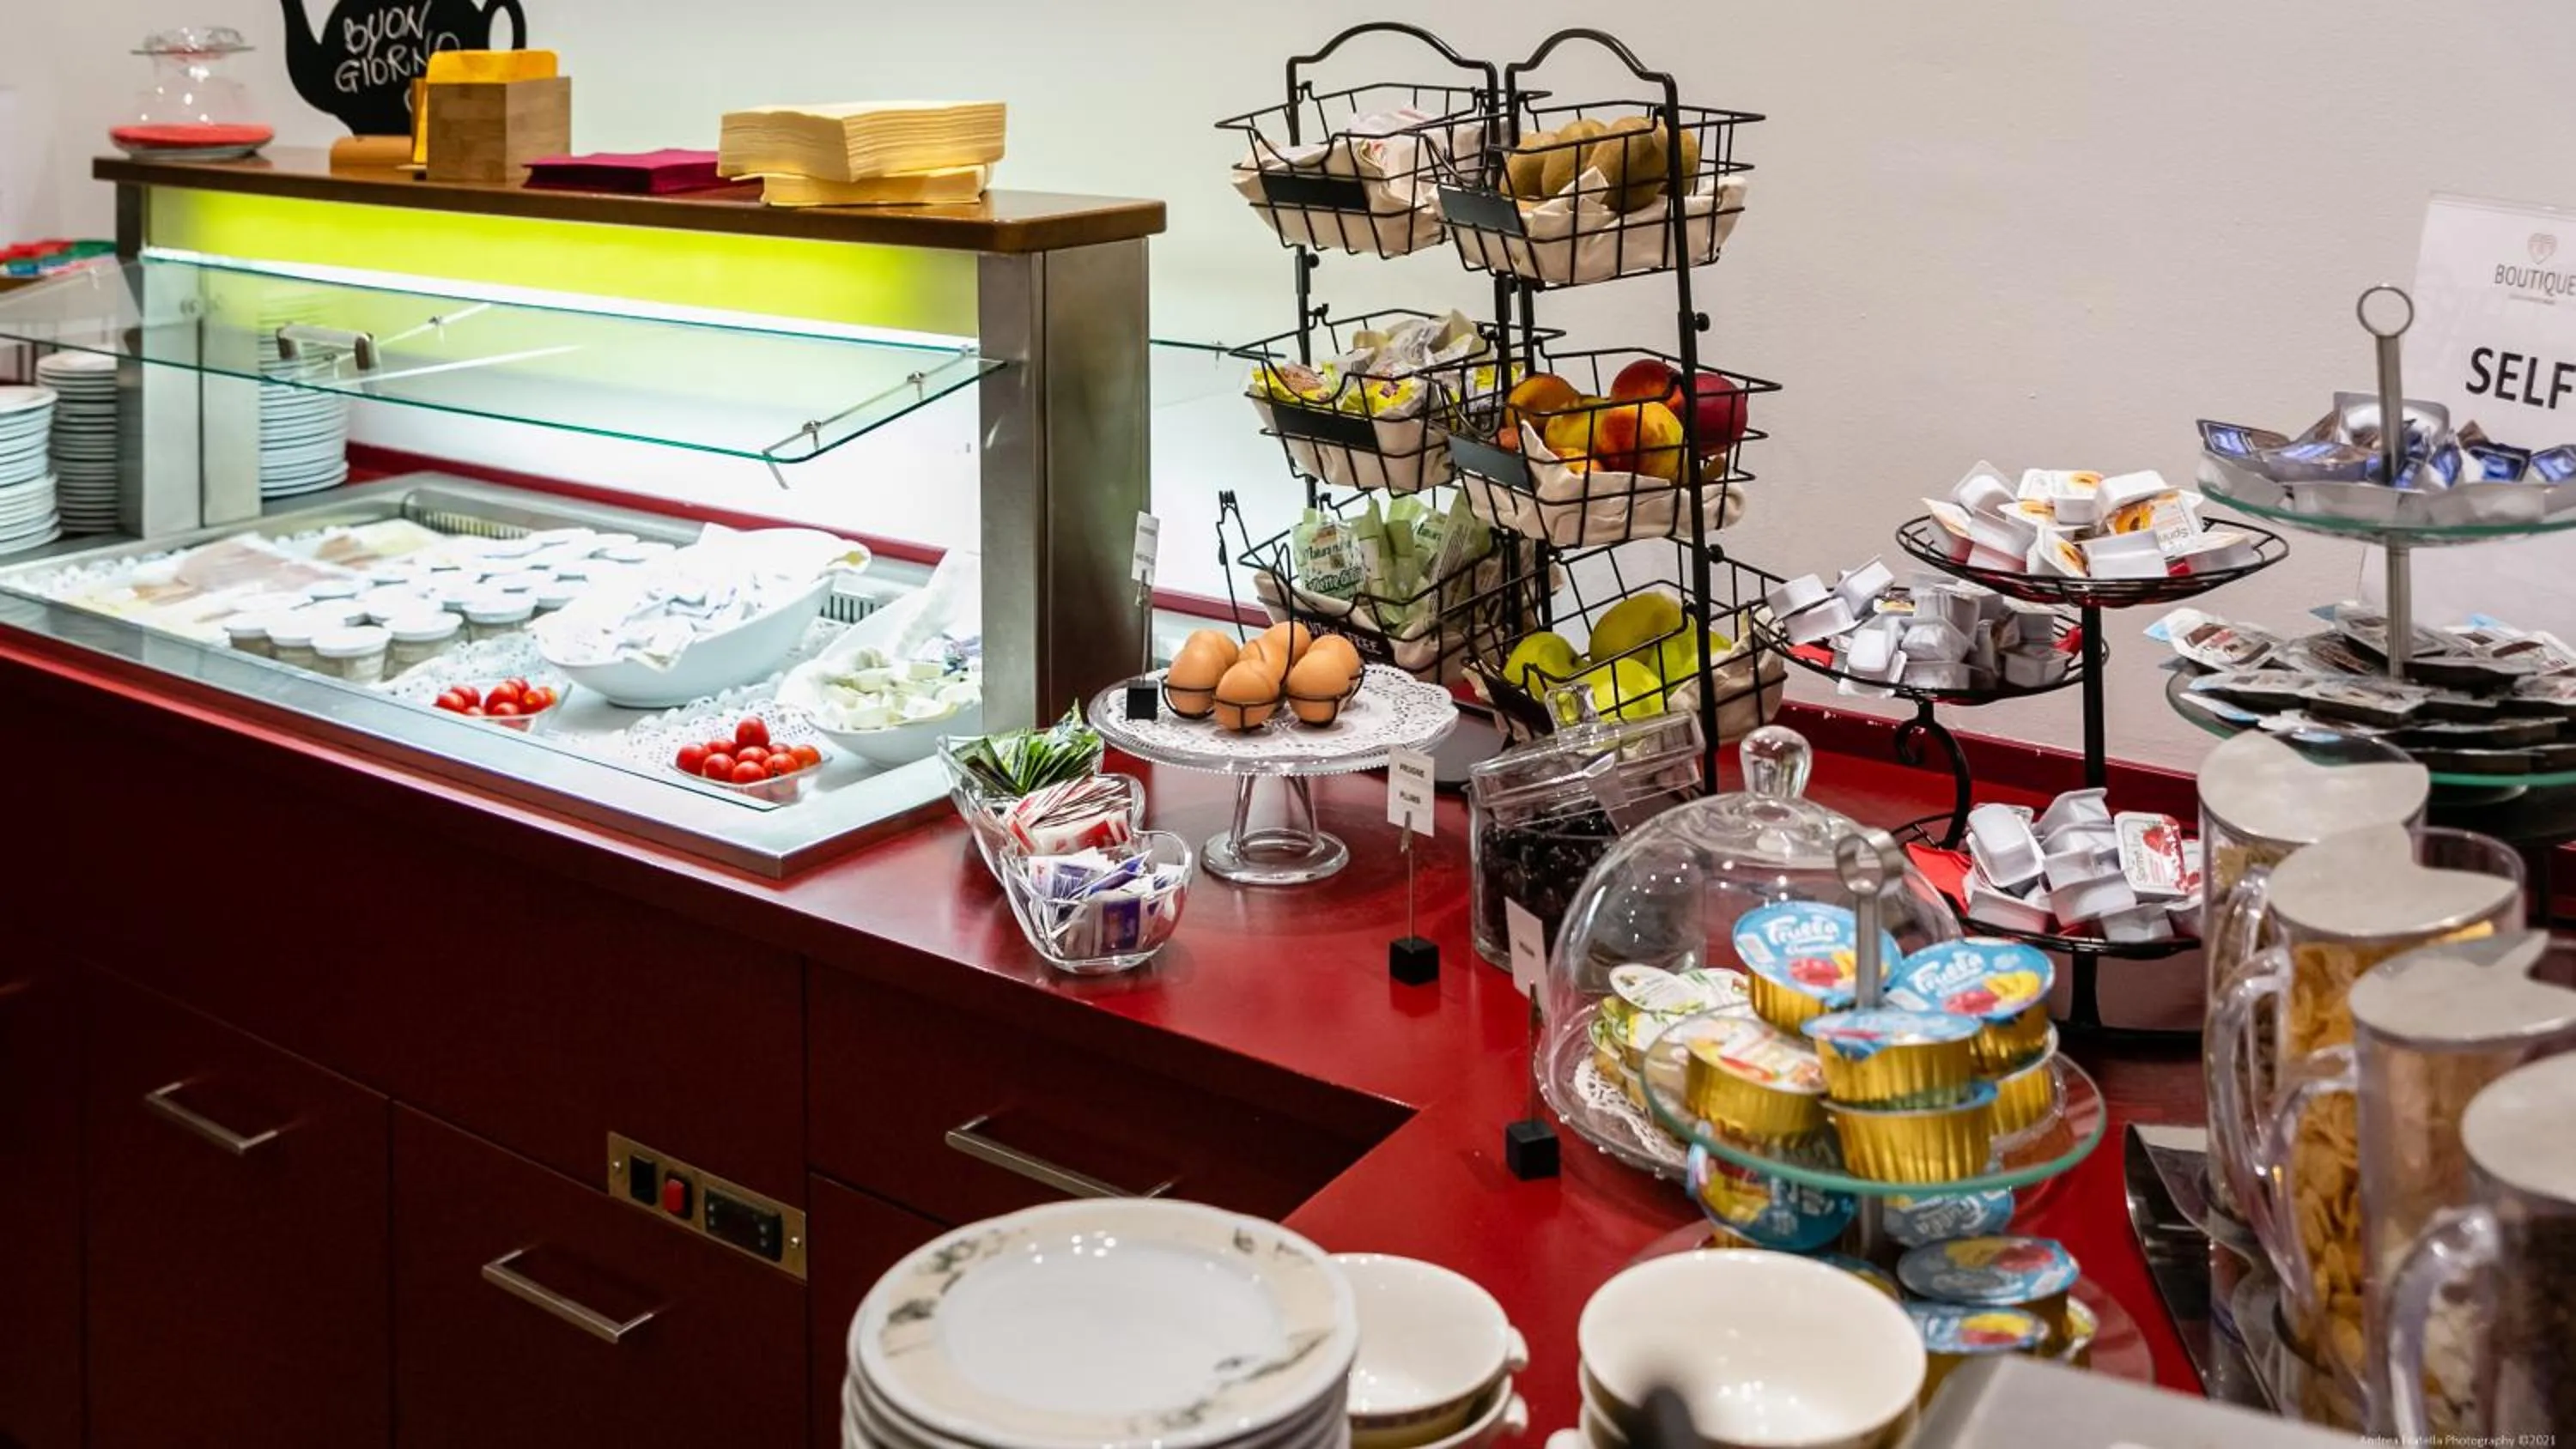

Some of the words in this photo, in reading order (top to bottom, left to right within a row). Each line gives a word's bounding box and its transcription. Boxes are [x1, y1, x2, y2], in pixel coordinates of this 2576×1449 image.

[343, 0, 431, 59] BUON
[2494, 264, 2576, 296] BOUTIQUE
[2465, 347, 2576, 409] SELF
